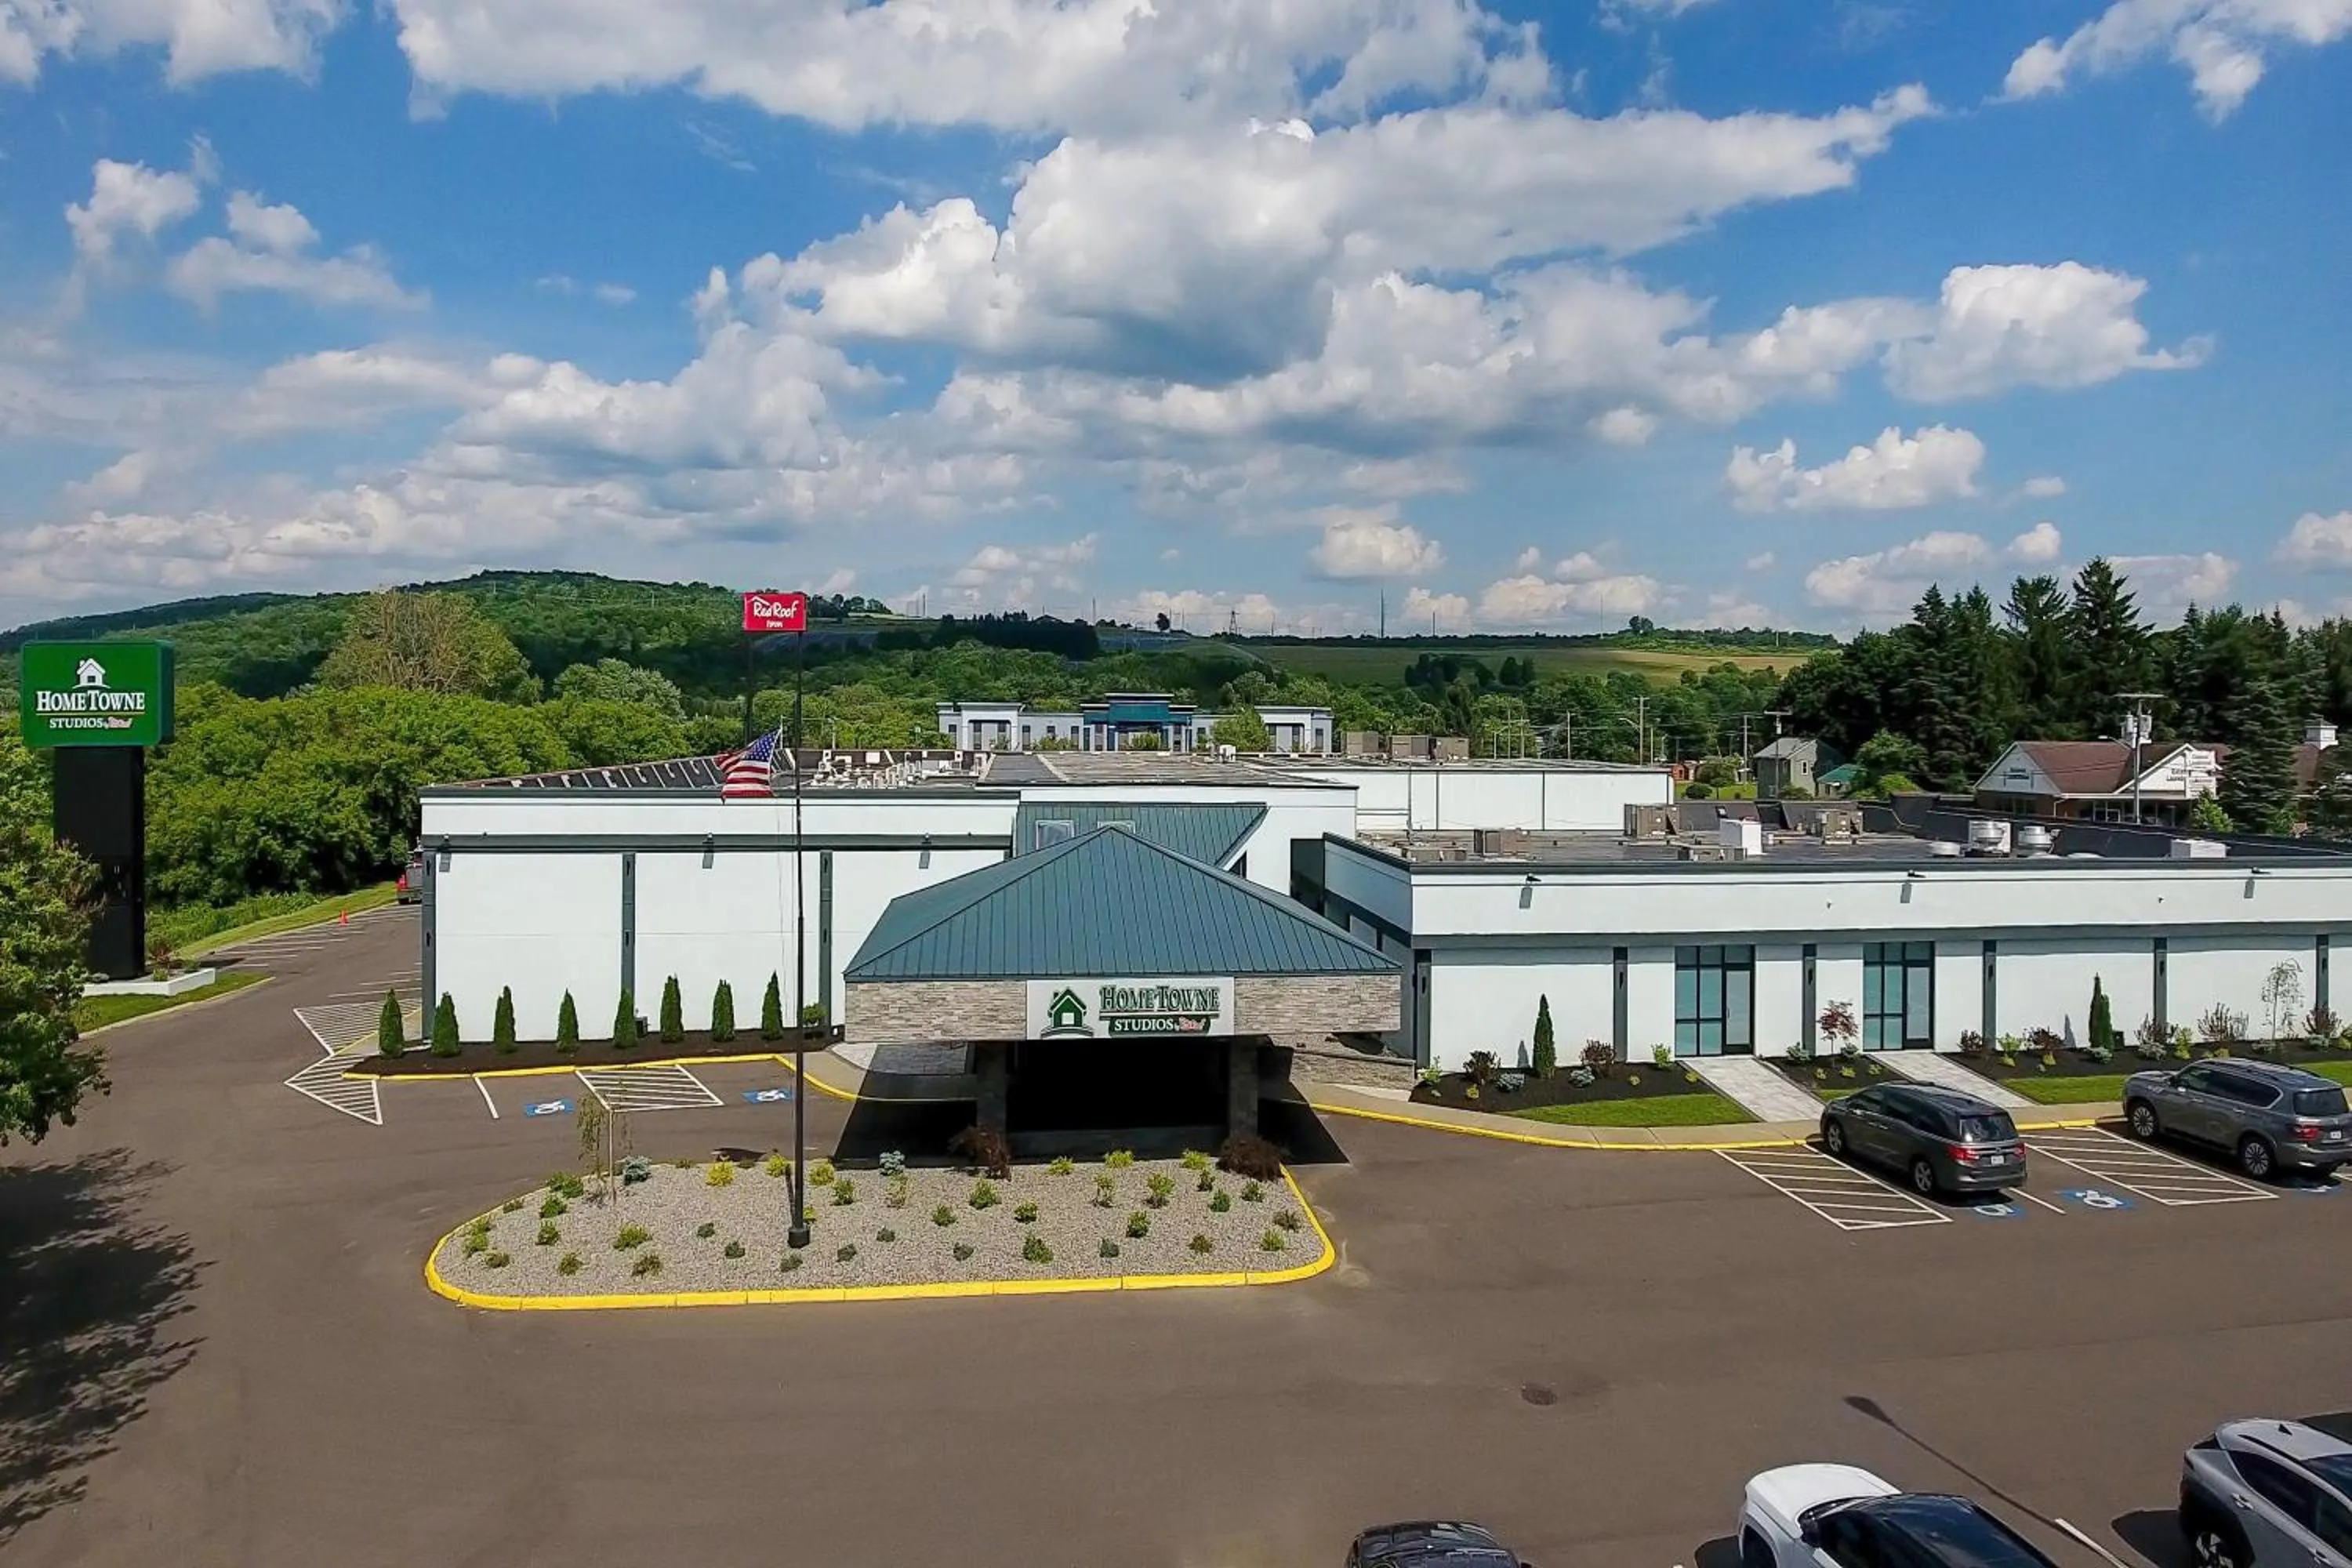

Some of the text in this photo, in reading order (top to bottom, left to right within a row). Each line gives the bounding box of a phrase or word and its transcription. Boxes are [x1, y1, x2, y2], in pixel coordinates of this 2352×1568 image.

[36, 690, 146, 711] HOMETOWNE
[49, 717, 103, 728] STUDIOS
[1099, 984, 1221, 1012] HOMETOWNE
[1114, 1018, 1174, 1032] STUDIOS
